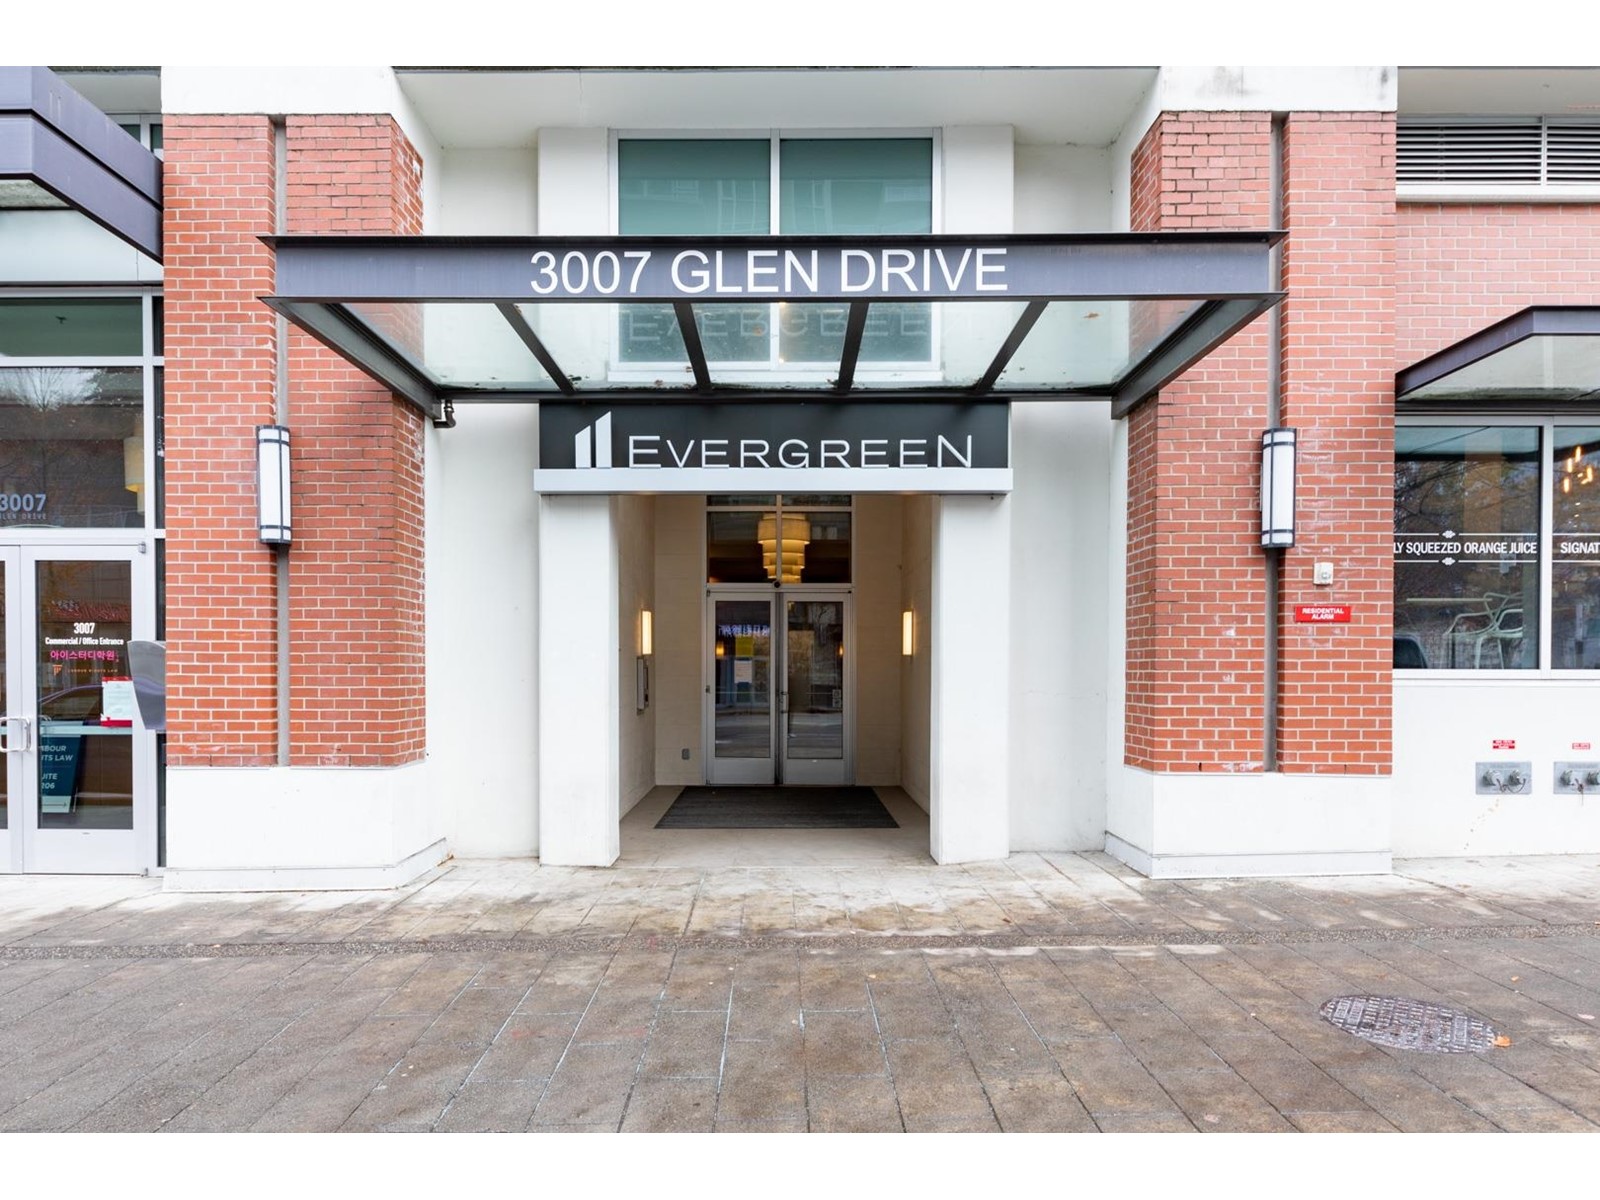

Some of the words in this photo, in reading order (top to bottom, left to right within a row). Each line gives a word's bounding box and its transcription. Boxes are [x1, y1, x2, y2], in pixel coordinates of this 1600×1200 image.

[530, 250, 652, 294] 3007
[671, 249, 818, 294] GLEN
[841, 248, 1008, 292] DRIVE
[628, 434, 972, 469] EVERGREEN
[0, 493, 46, 511] 3007
[0, 512, 17, 520] LEN
[1405, 541, 1461, 556] SQUEEZED
[1464, 542, 1507, 554] ORANGE
[1508, 542, 1537, 554] JUICE
[73, 622, 95, 634] 3007
[45, 637, 78, 645] Commercial
[82, 637, 99, 645] Office
[99, 637, 124, 645] Entrance
[50, 650, 115, 660] 아이스터디학원
